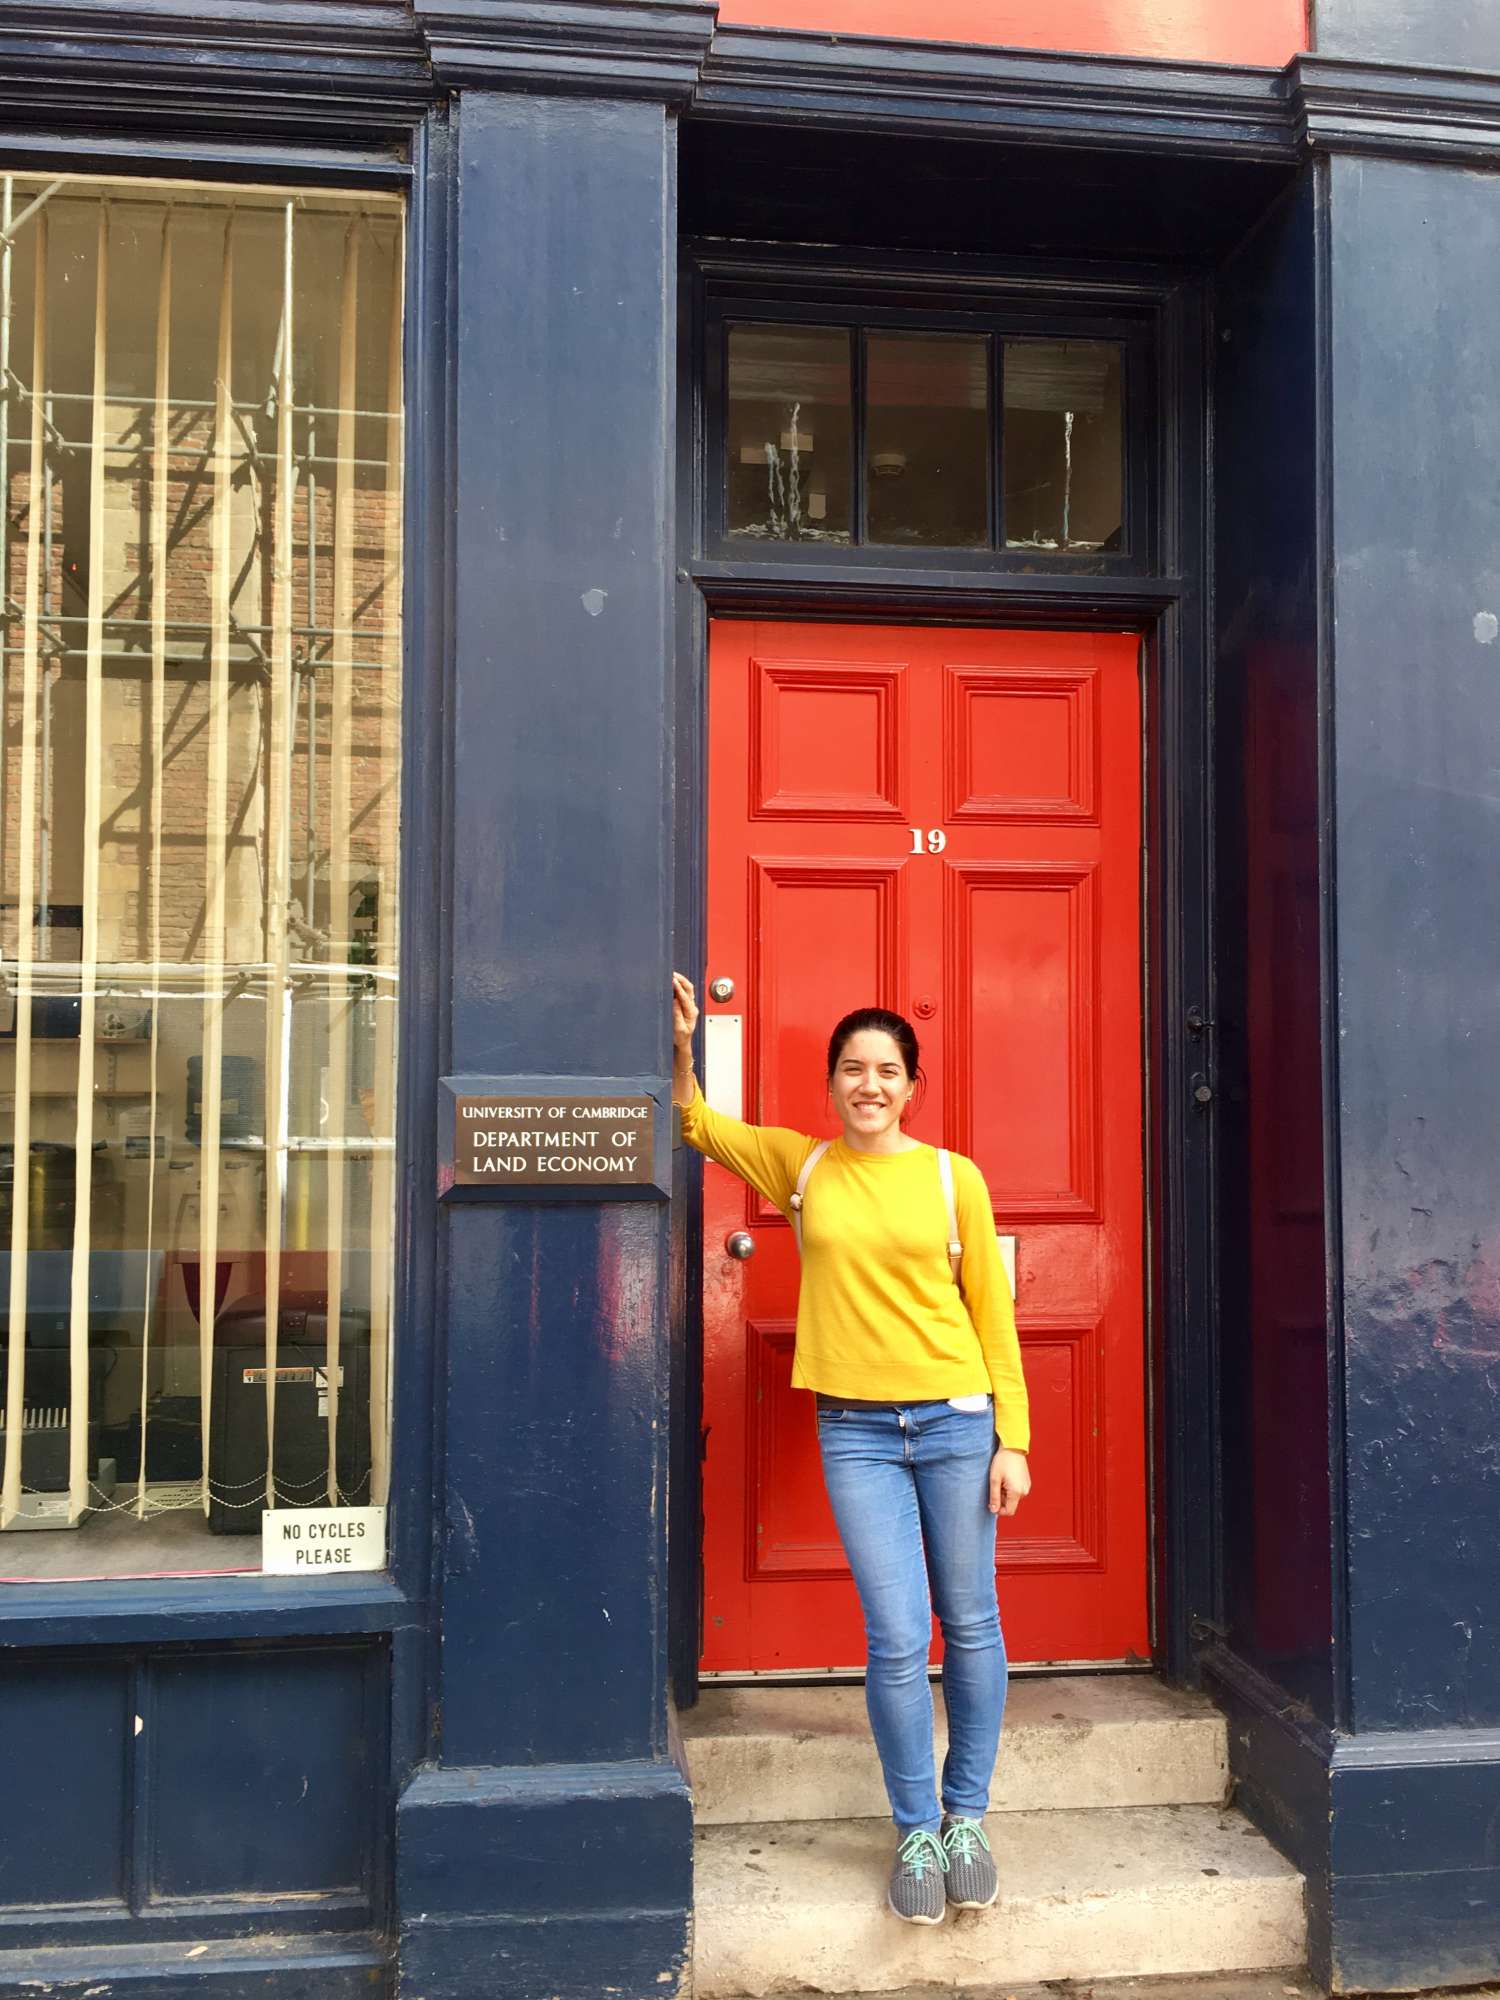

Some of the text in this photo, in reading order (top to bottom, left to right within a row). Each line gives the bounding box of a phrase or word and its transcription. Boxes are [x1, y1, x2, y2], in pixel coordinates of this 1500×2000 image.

[908, 828, 946, 854] 19
[462, 1106, 648, 1119] UNIVERSITY OF CAMBRIDGE
[472, 1131, 637, 1148] DEPARTMENT OF
[472, 1156, 638, 1172] LAND ECONOMY
[282, 1522, 366, 1540] NO CYCLES
[296, 1548, 352, 1565] PLEASE
